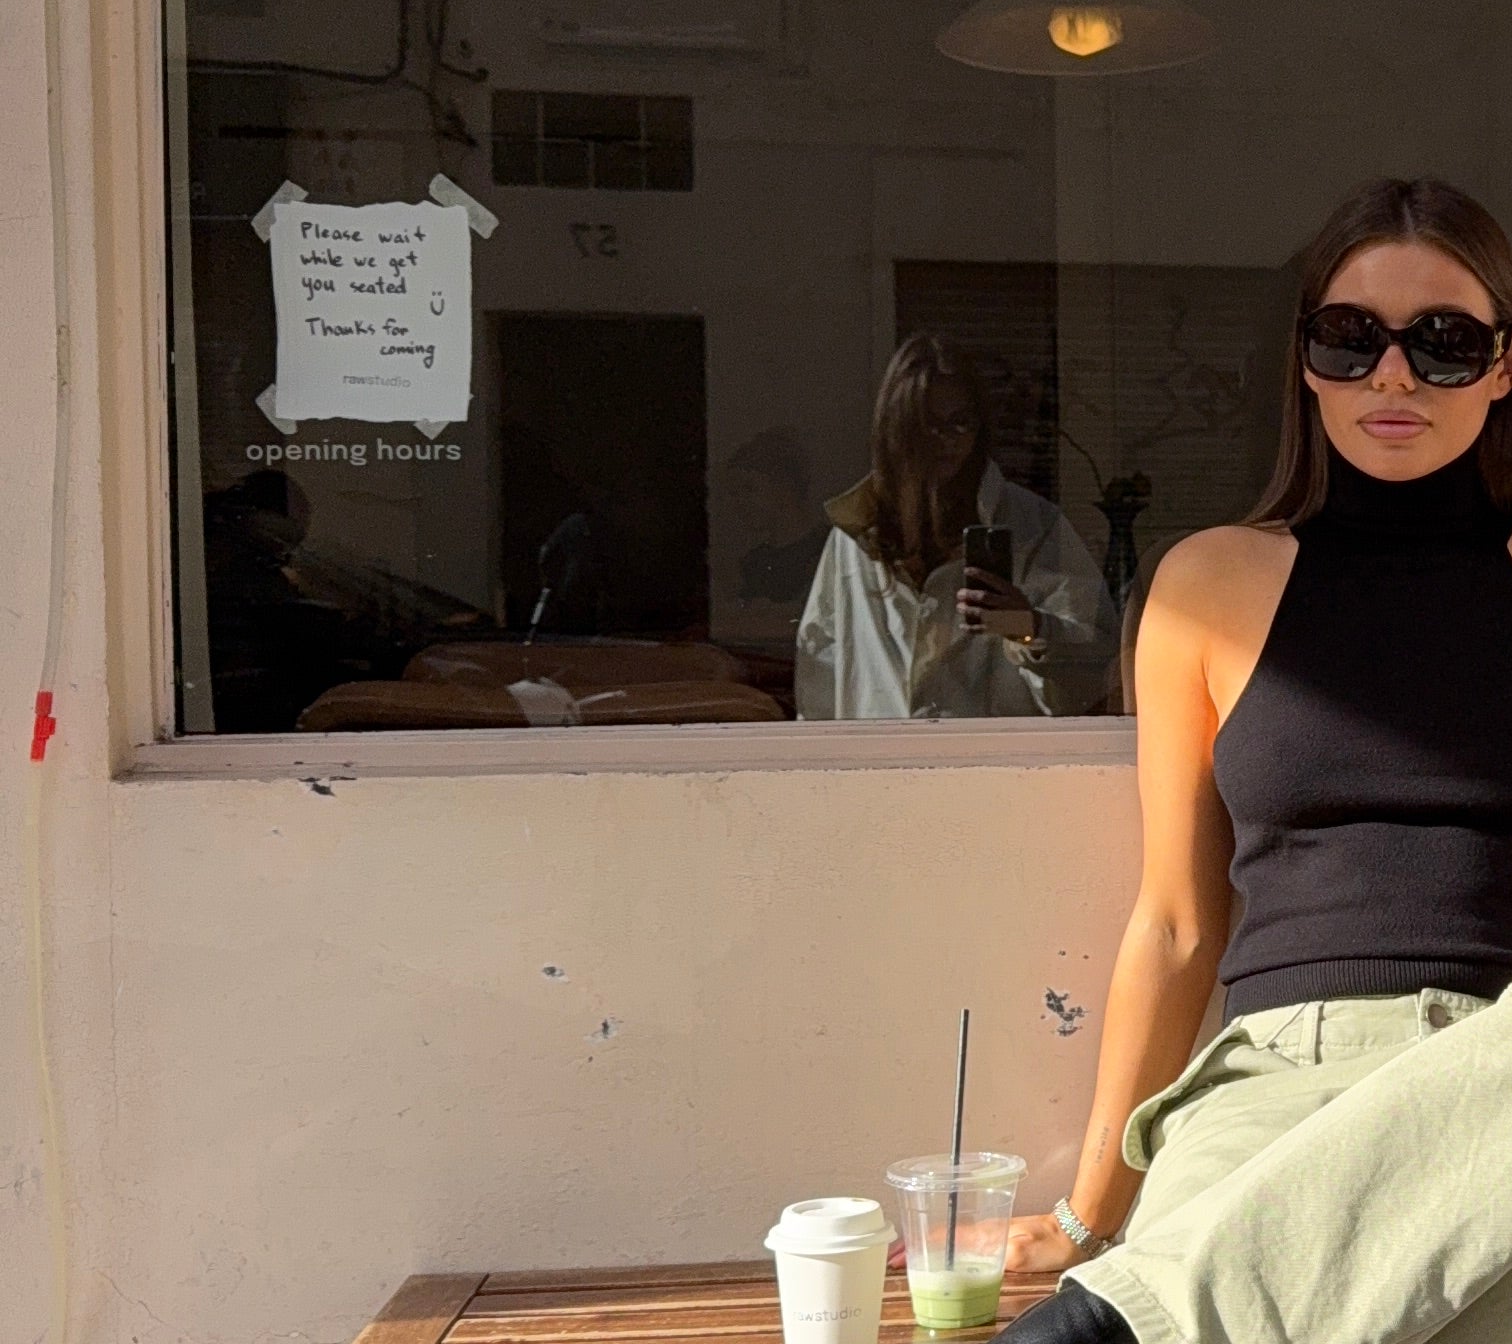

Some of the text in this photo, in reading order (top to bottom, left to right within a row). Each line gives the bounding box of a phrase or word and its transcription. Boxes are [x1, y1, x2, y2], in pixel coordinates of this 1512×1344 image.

[301, 221, 426, 243] Please wait
[300, 248, 418, 277] while we get
[302, 276, 407, 301] you seated
[305, 316, 409, 336] Thanks for
[379, 341, 436, 369] coming
[246, 437, 462, 466] opening hours
